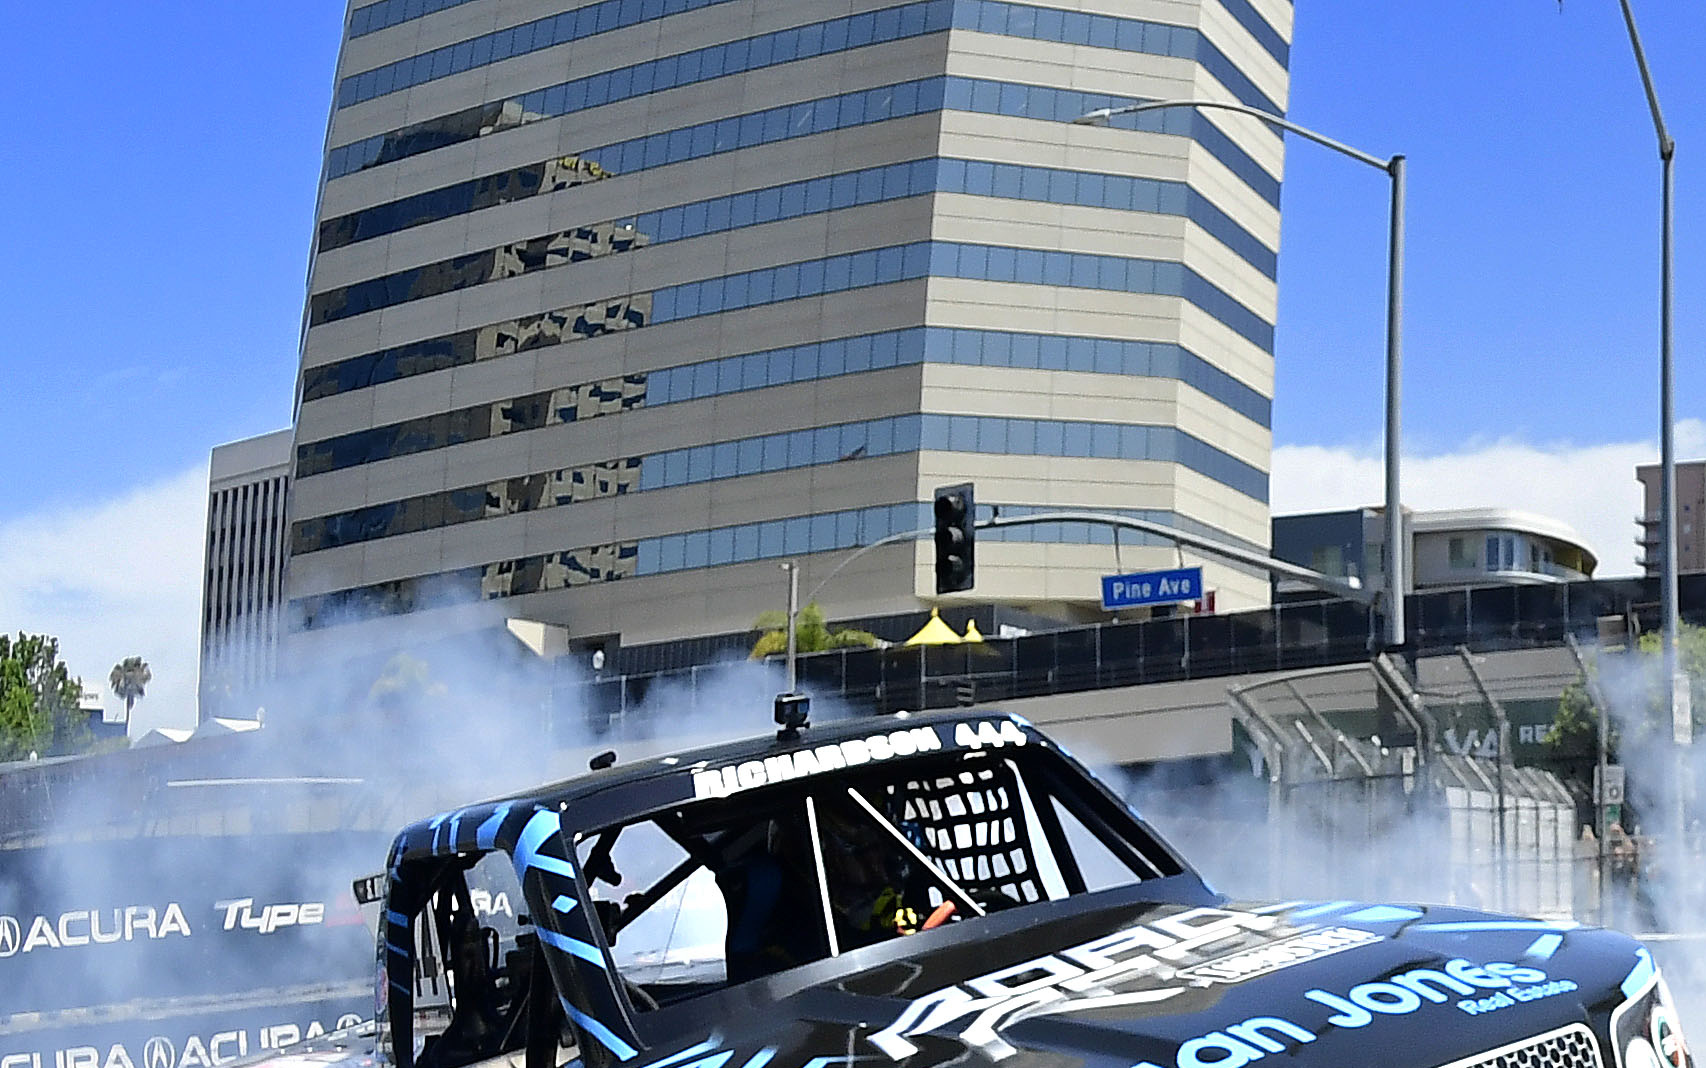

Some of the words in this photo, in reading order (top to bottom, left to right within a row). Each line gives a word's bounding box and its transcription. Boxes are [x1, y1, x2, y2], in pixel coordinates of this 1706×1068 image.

[1112, 581, 1152, 601] Pine
[1158, 576, 1192, 597] Ave
[692, 726, 942, 800] RICHARDSON
[953, 720, 1028, 749] 444
[22, 902, 192, 953] ACURA
[213, 898, 325, 933] Type
[1304, 958, 1548, 1029] Jones
[1456, 991, 1516, 1016] Real
[1506, 978, 1579, 1003] Estate
